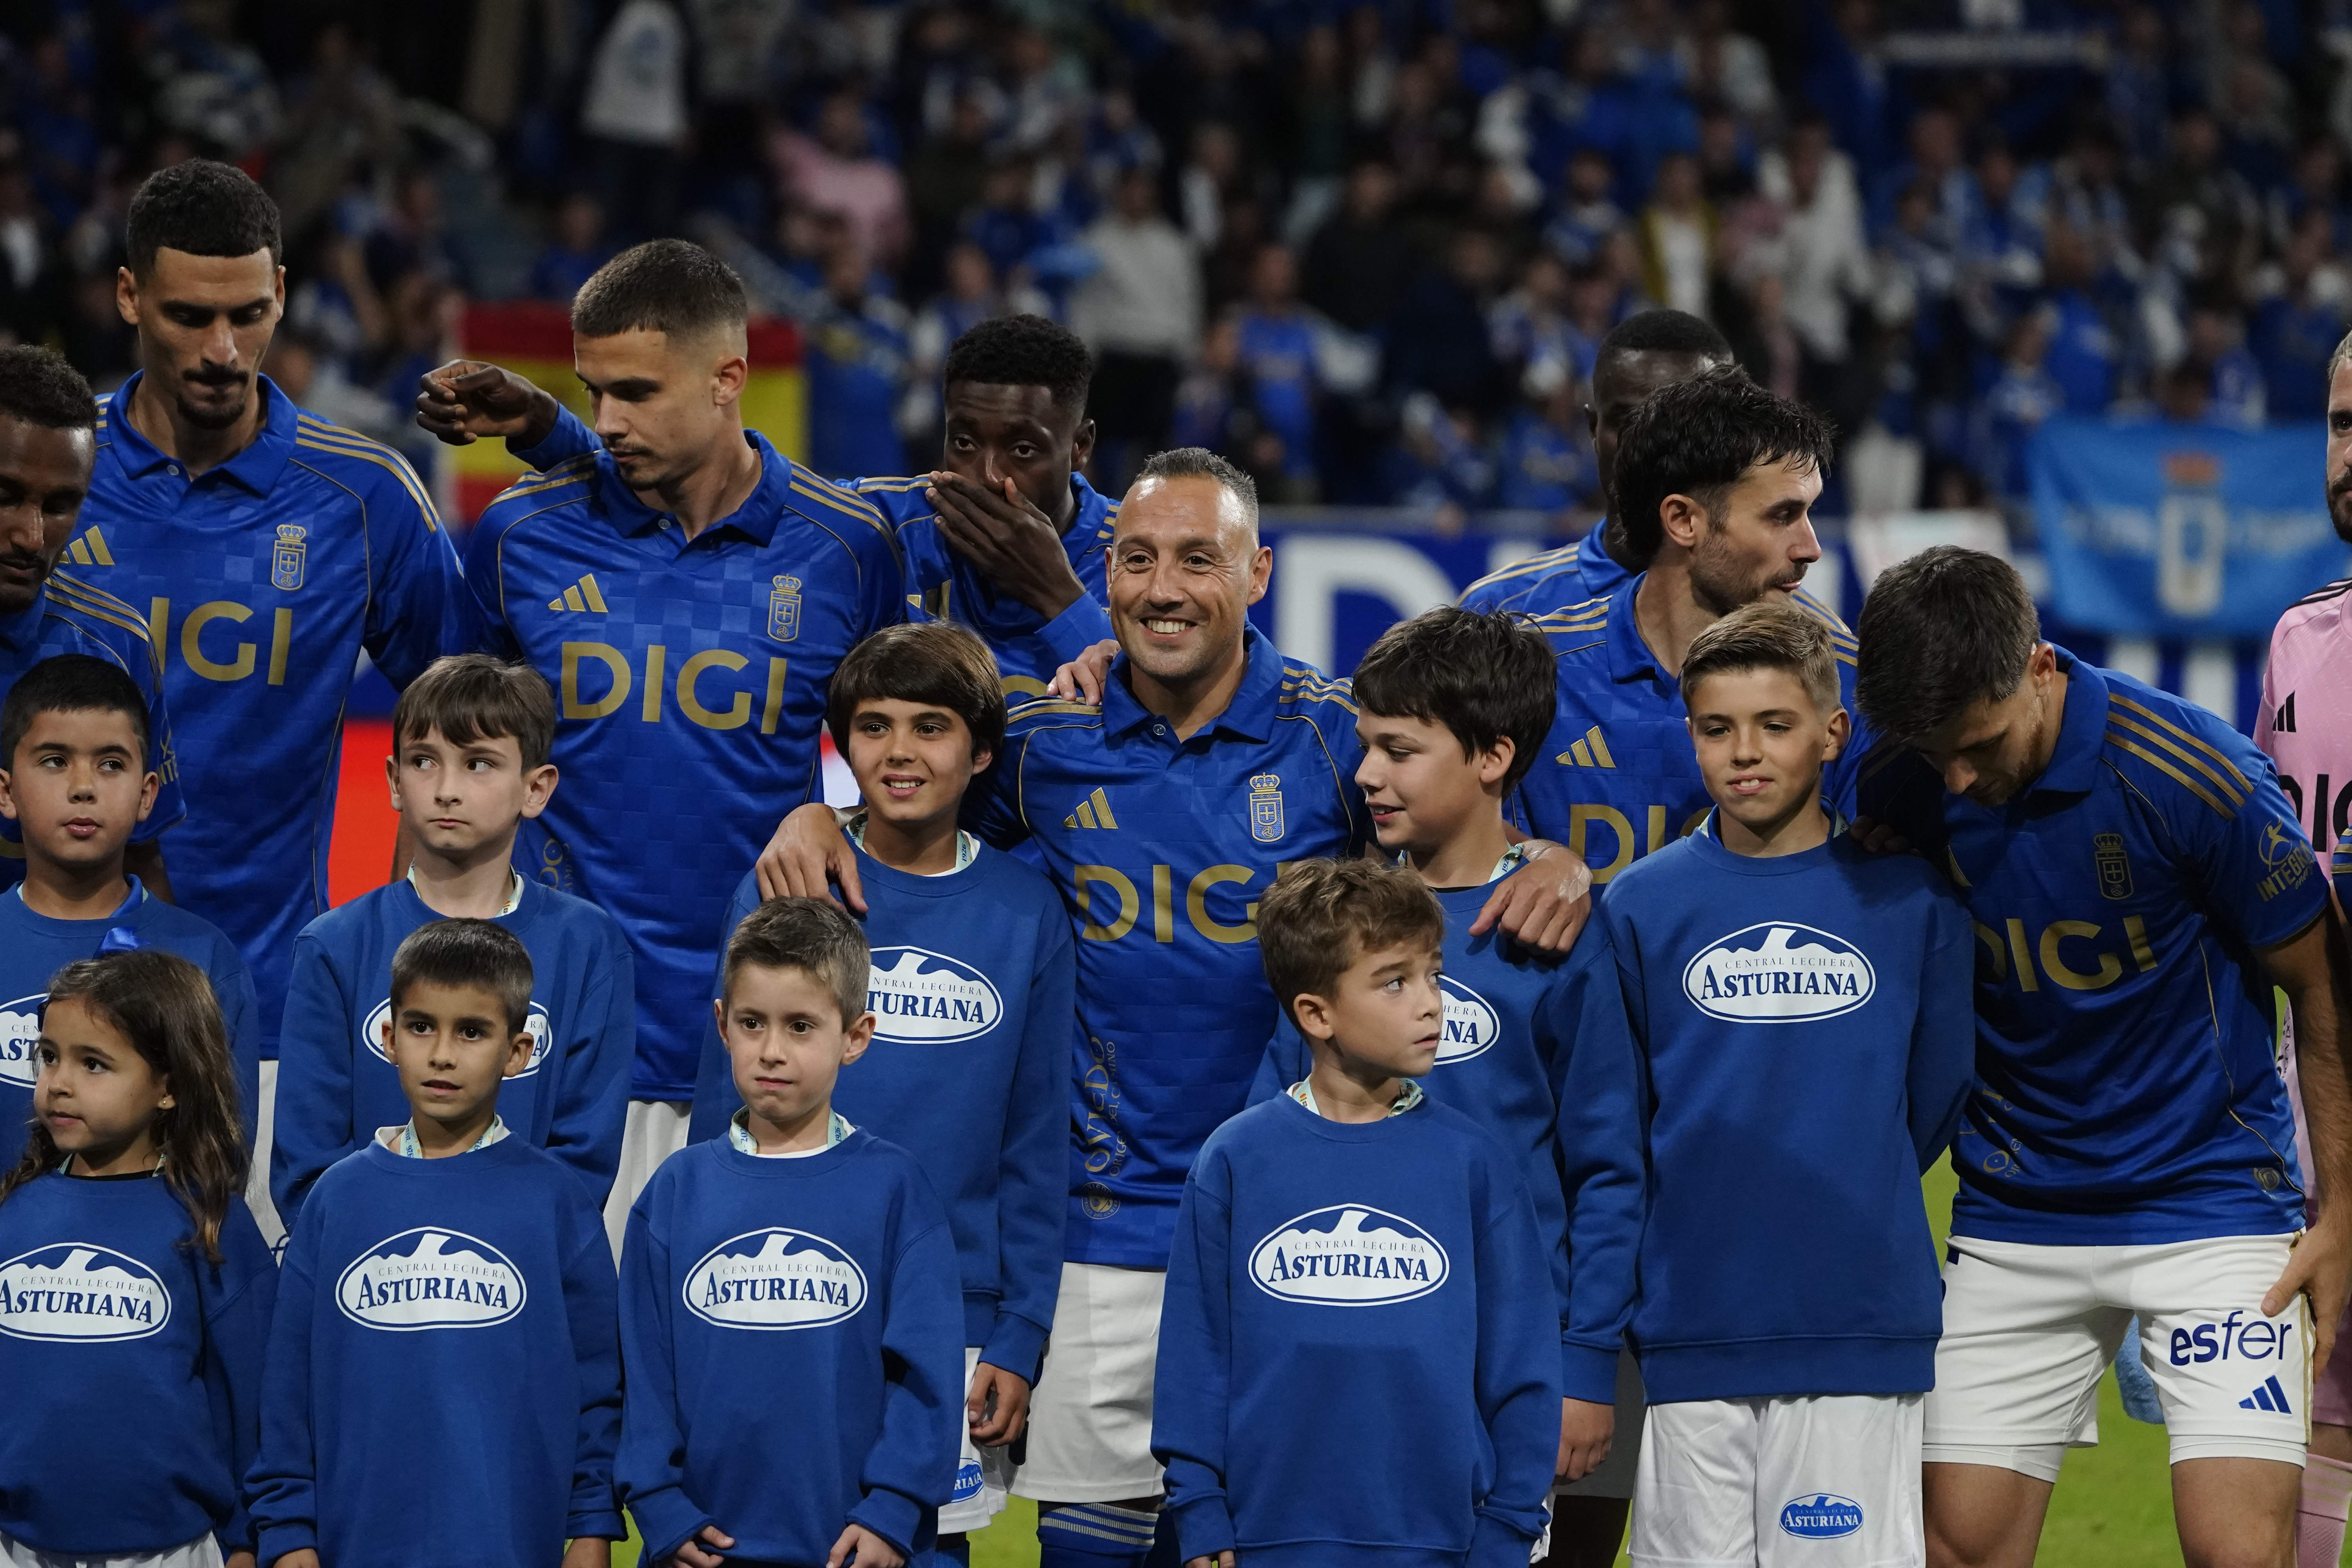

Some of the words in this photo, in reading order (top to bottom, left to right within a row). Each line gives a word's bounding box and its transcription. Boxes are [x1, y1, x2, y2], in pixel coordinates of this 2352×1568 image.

[149, 597, 292, 685] IGI
[561, 642, 786, 734] DIGI
[1074, 864, 1294, 943] DIG
[1726, 957, 1782, 969] CENTRAL
[1791, 957, 1855, 968] LECHERA
[873, 977, 914, 989] NTRAL
[922, 982, 982, 996] LECHERA
[1701, 964, 1860, 1000] ASTURIANA
[866, 990, 985, 1024] TURIANA
[1444, 1005, 1477, 1016] HERA
[1295, 1239, 1356, 1251] CENTRAL
[1363, 1241, 1425, 1253] LECHERA
[379, 1263, 436, 1276] CENTRAL
[444, 1263, 506, 1279] LECHERA
[723, 1264, 780, 1275] CENTRAL
[788, 1264, 848, 1277] LECHERA
[1268, 1247, 1430, 1282] ASTURIANA
[0, 1279, 152, 1325] ASTURIANA
[22, 1276, 81, 1286] CENTRAL
[88, 1279, 152, 1295] LECHERA
[356, 1273, 509, 1310] ASTURIANA
[703, 1272, 849, 1308] ASTURIANA
[2170, 1310, 2292, 1366] esfer
[1784, 1510, 1859, 1527] ASTURIANA
